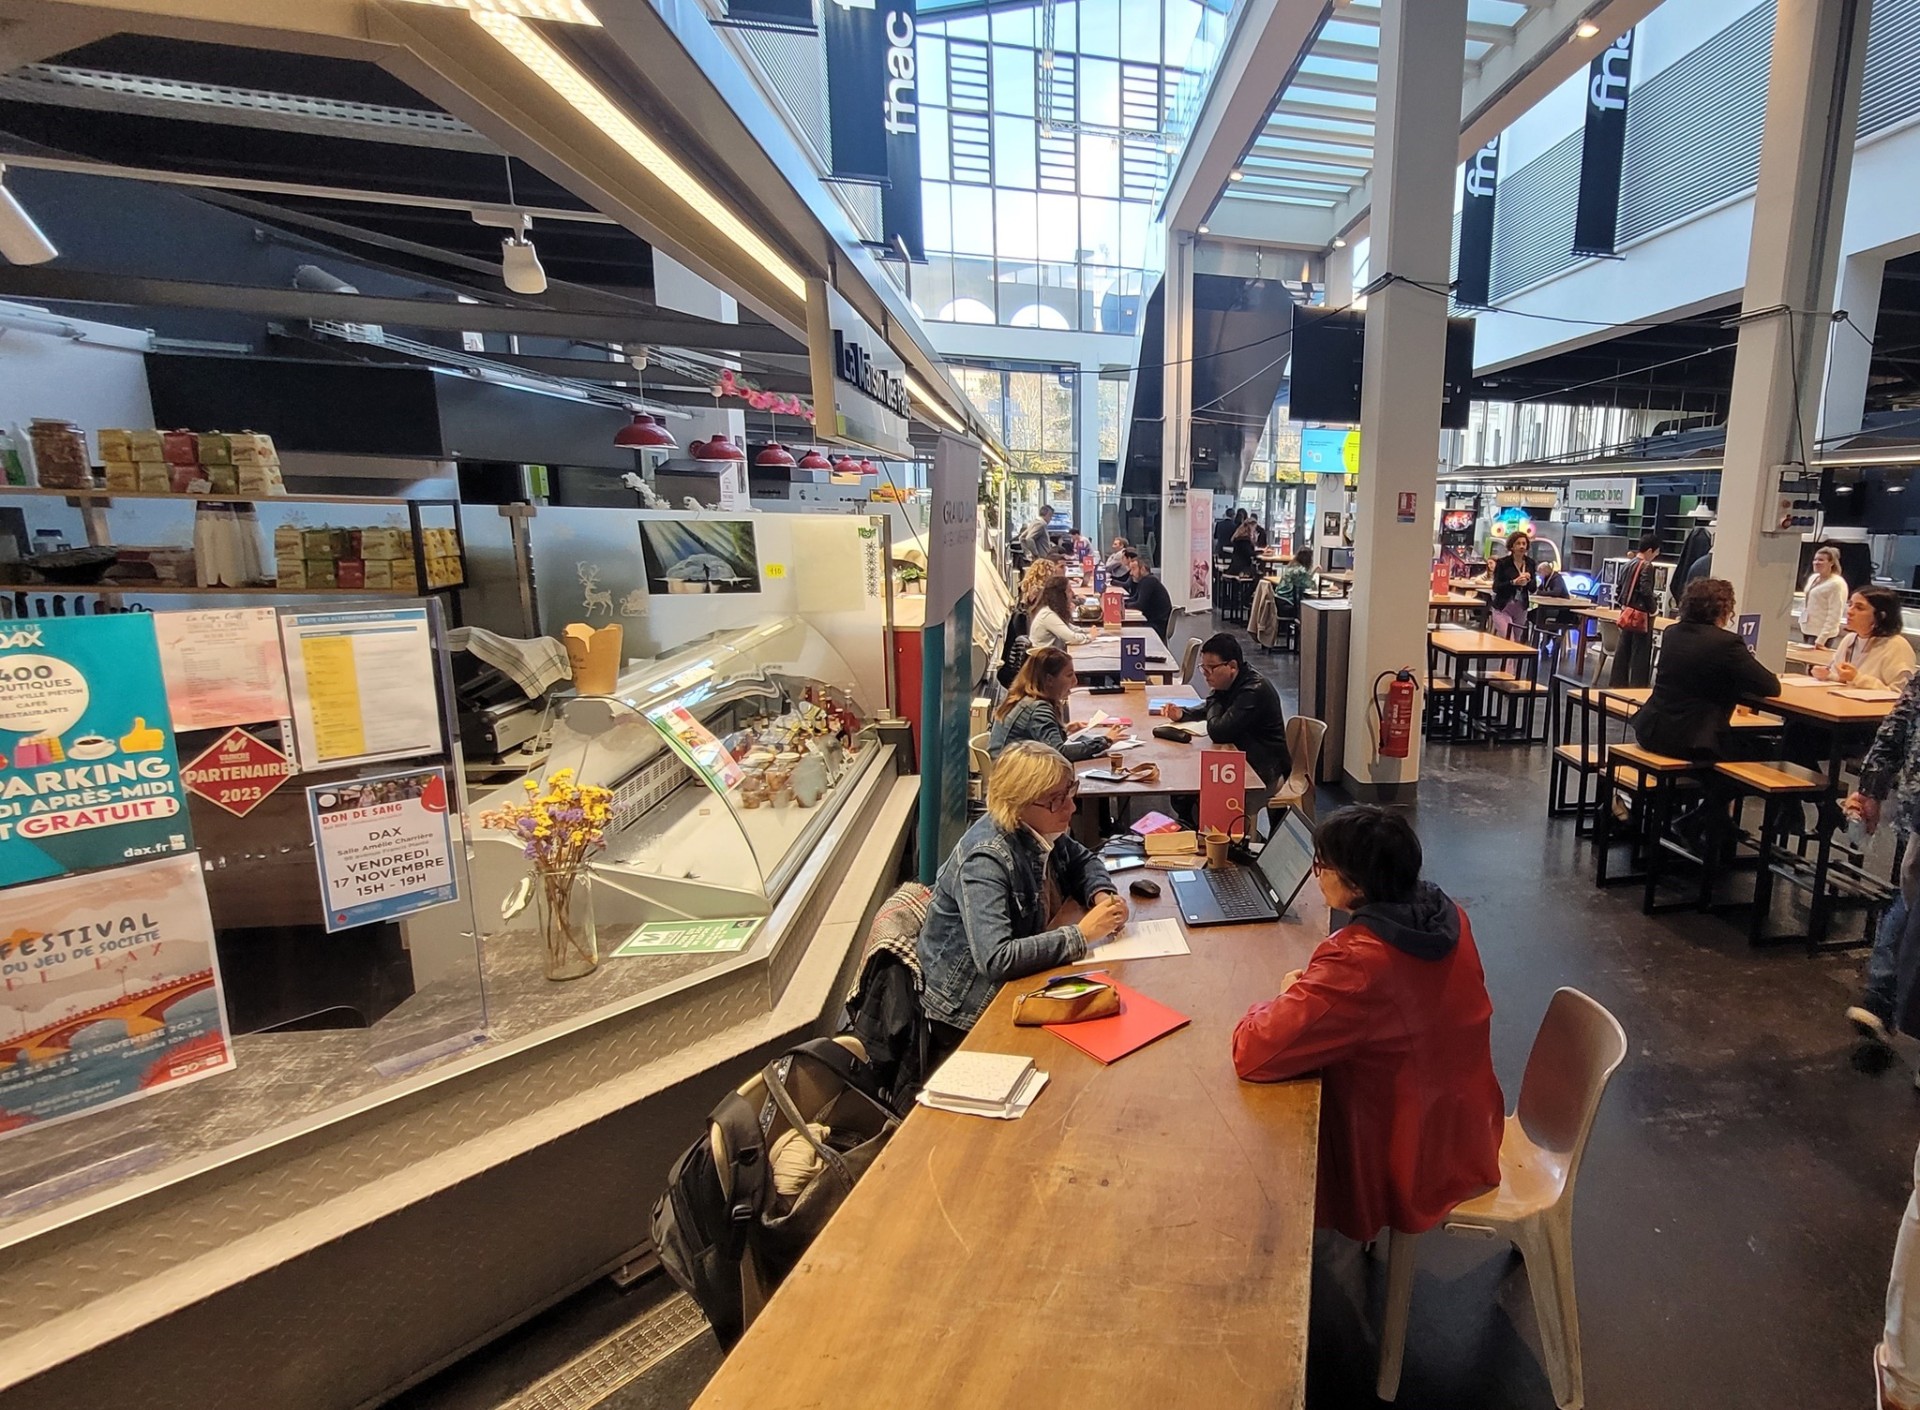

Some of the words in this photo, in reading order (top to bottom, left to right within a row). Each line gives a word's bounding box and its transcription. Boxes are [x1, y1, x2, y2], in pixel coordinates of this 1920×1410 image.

[884, 11, 916, 135] fnac
[1437, 569, 1446, 577] 18
[1107, 597, 1118, 605] 14
[1742, 621, 1755, 636] 17
[1125, 643, 1141, 657] 15
[185, 762, 290, 785] PARTENAIRE
[1209, 763, 1237, 784] 16
[30, 780, 174, 813] APRÈS-MIDI
[220, 787, 261, 803] 2023
[24, 801, 155, 834] GRATUIT
[166, 799, 175, 812] !
[322, 813, 348, 825] DON
[353, 810, 367, 819] DE
[372, 803, 402, 815] SANG
[337, 847, 359, 856] Salle
[362, 840, 392, 852] Amélie
[395, 832, 433, 845] Charrière
[369, 827, 402, 841] DAX
[124, 842, 169, 857] dax.fr
[347, 848, 429, 873] VENDREDI
[333, 878, 350, 889] 17
[355, 857, 445, 884] NOVEMBRE
[356, 883, 385, 896] 15H
[400, 874, 426, 887] 19H
[0, 913, 158, 961] FESTIVAL
[2, 961, 28, 975] DU
[34, 953, 67, 969] JEU
[72, 946, 94, 960] DE
[94, 1028, 166, 1055] NOVEMBRE
[169, 1018, 203, 1033] 2023
